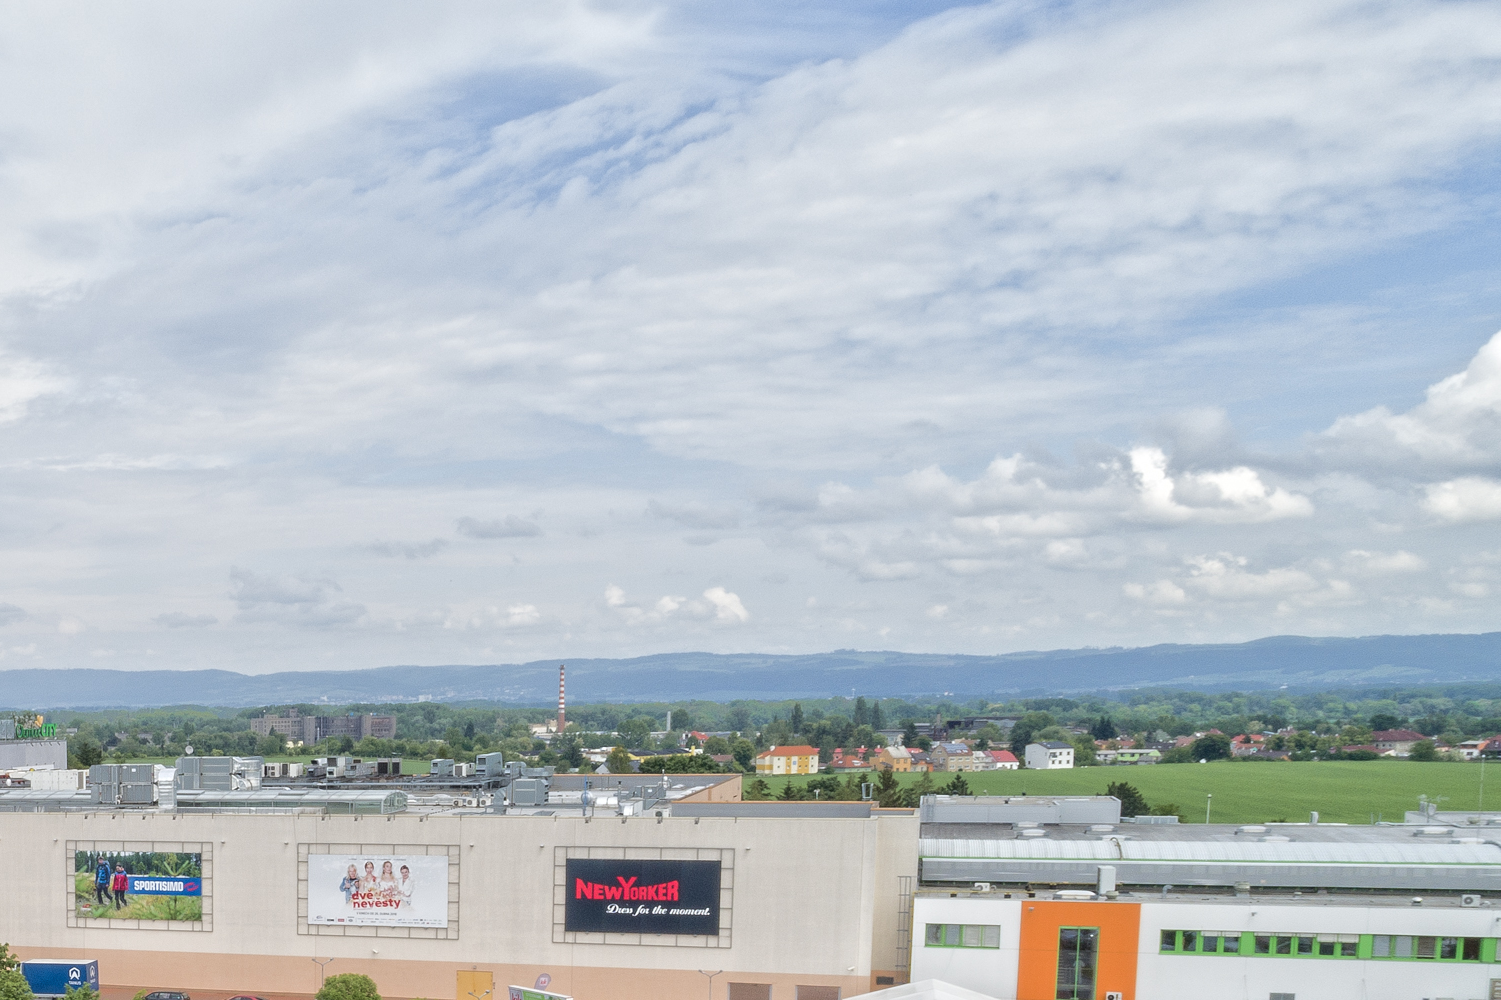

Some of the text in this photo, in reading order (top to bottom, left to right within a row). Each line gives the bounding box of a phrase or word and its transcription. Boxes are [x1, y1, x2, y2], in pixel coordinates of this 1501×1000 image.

[134, 881, 183, 892] SPORTISIMO
[351, 890, 373, 900] dvě
[353, 897, 401, 909] nevěsty
[606, 904, 710, 916] Dress for the moment.
